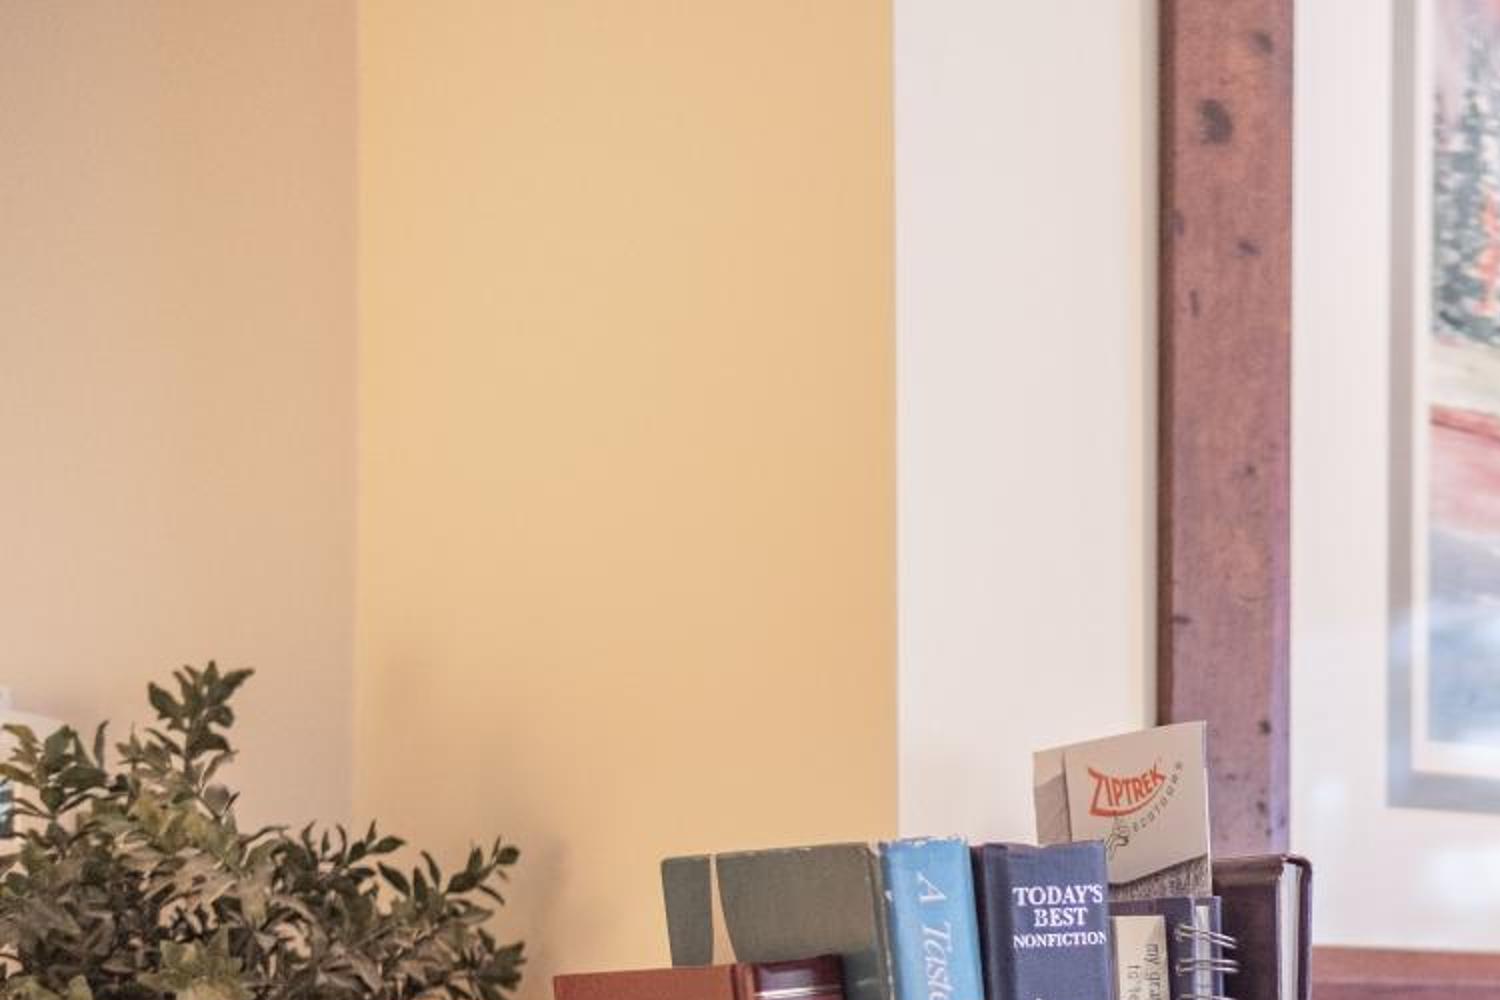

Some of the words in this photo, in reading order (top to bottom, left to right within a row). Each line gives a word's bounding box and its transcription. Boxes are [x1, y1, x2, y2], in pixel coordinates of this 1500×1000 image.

[1088, 761, 1166, 817] ZIPTREK
[916, 871, 948, 903] A
[1012, 883, 1104, 907] TODAY'S
[1033, 906, 1089, 928] BEST
[1012, 931, 1108, 949] NONFICTION
[1143, 943, 1159, 964] my
